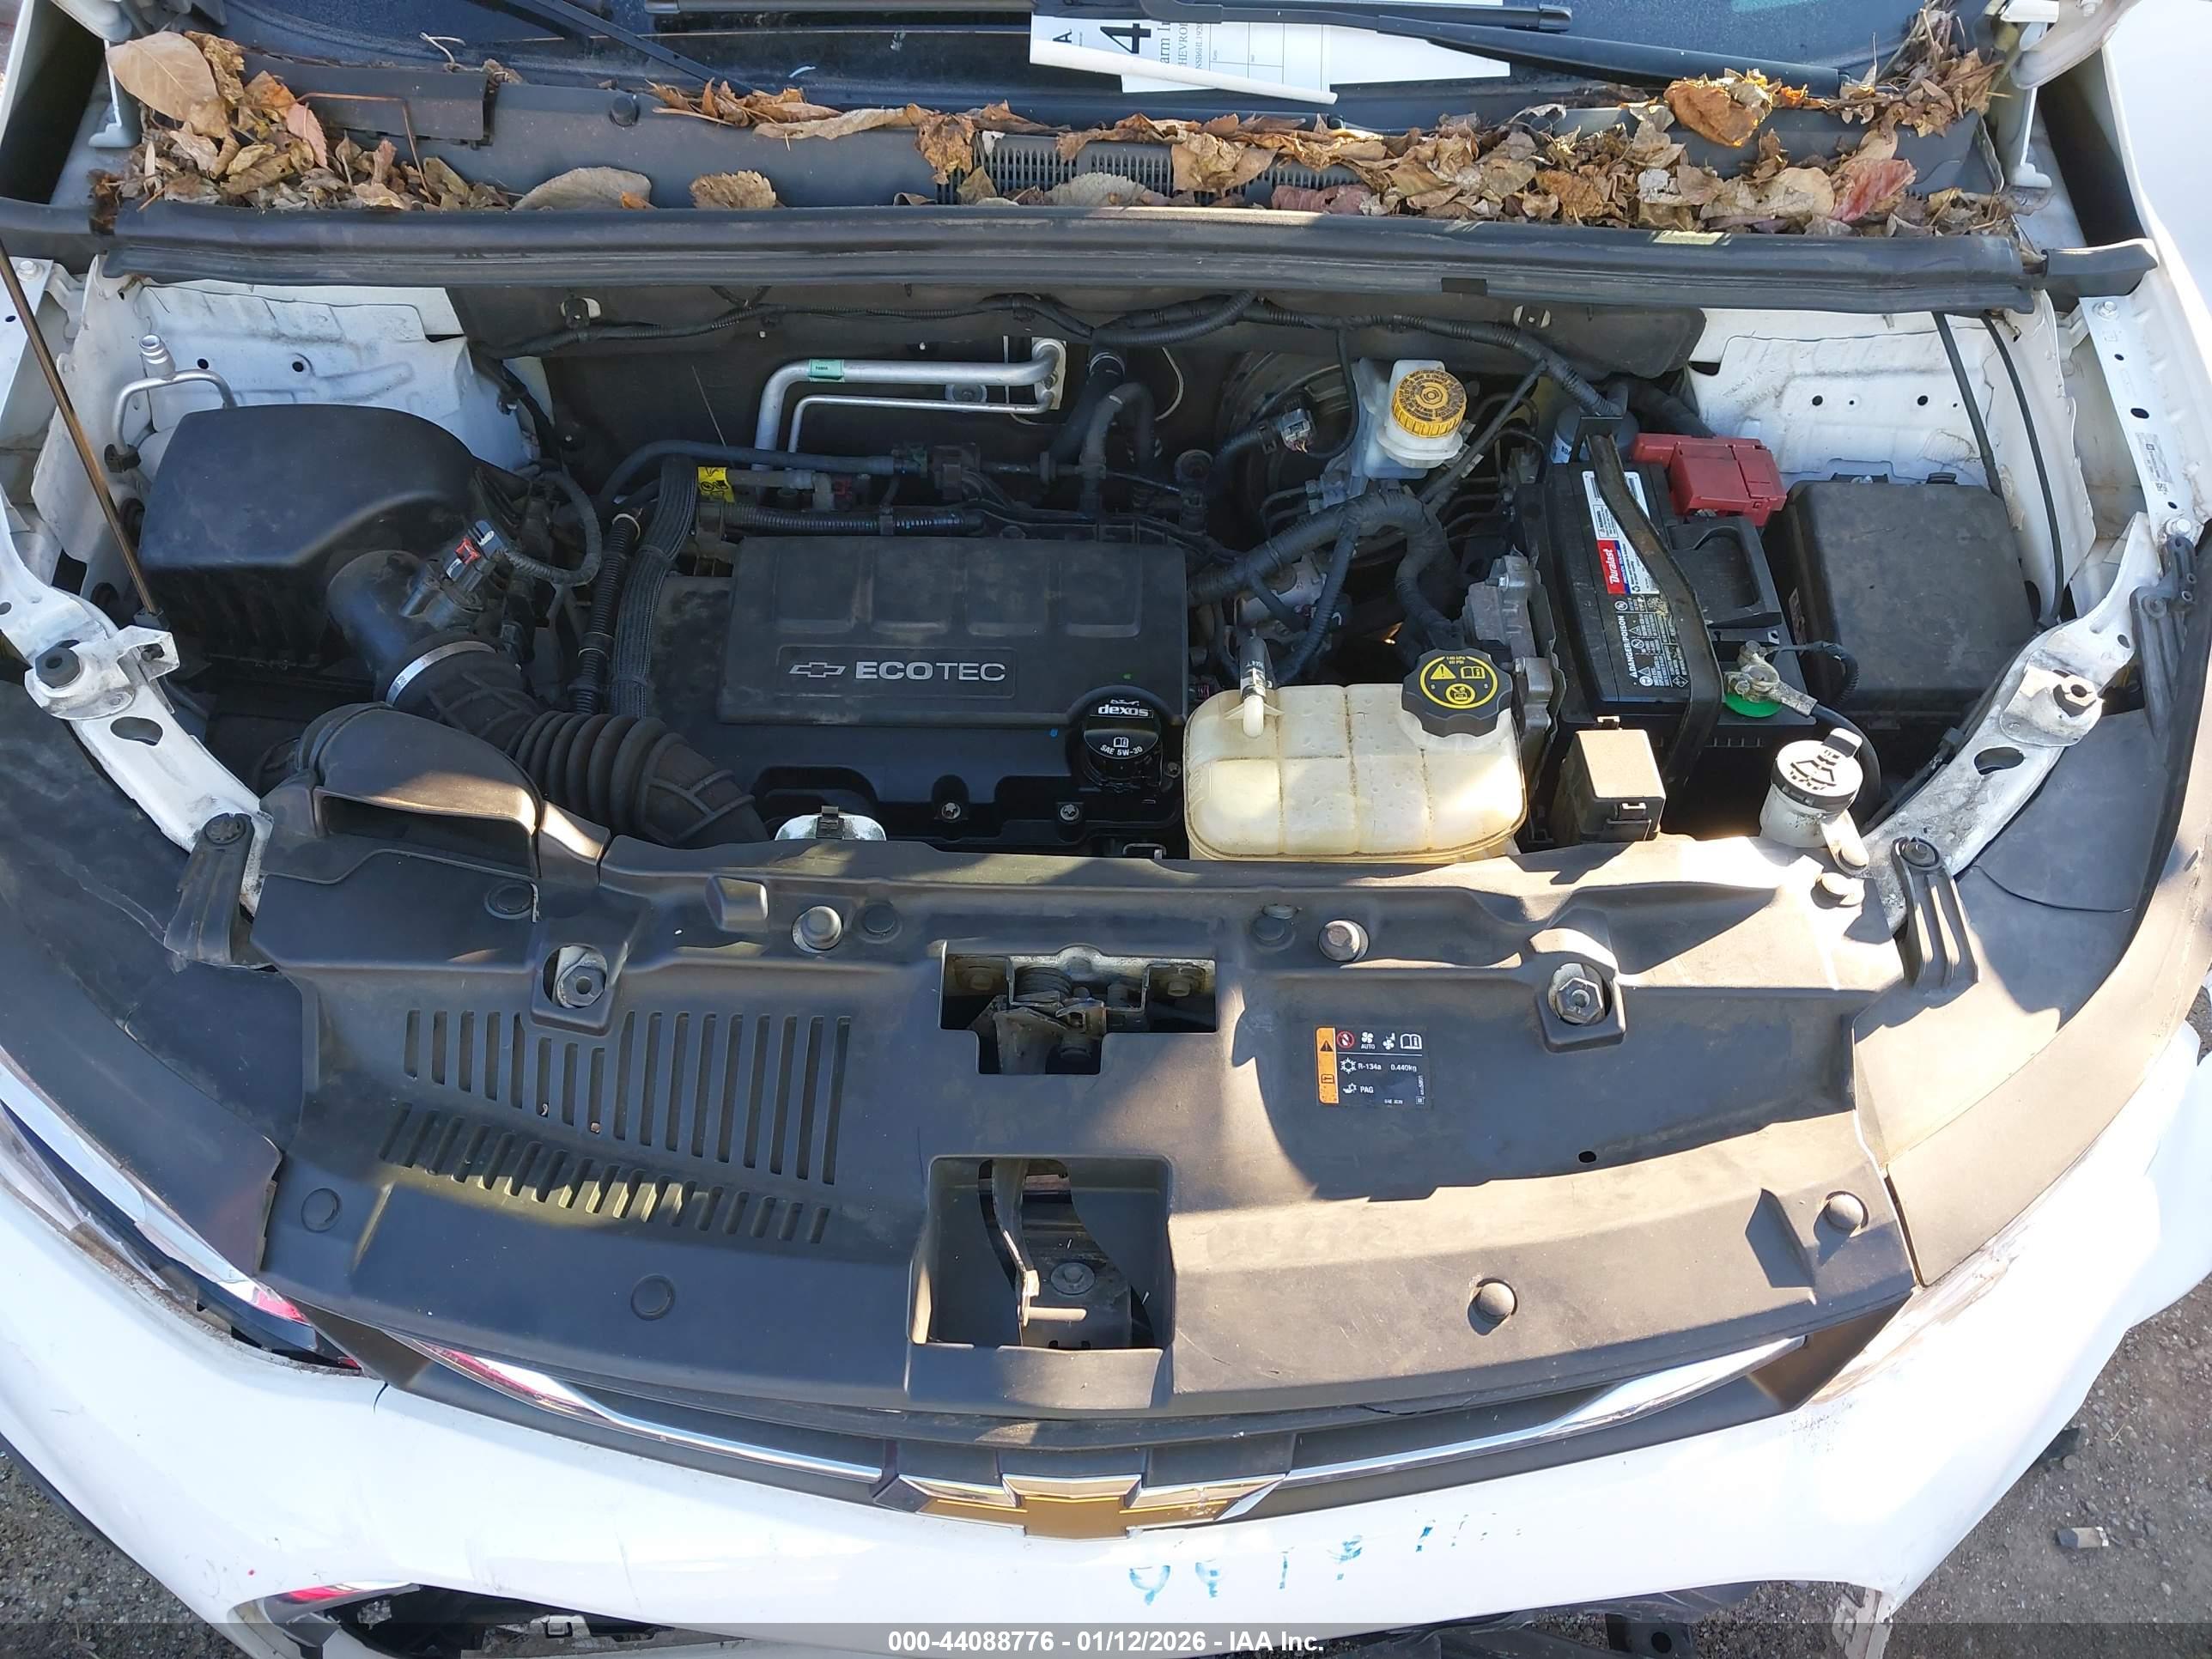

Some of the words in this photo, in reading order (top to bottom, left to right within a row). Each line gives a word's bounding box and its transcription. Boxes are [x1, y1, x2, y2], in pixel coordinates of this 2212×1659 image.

[1099, 22, 1152, 55] 4
[1602, 548, 1620, 584] Duralast
[854, 660, 1006, 682] ECOTEC
[1097, 703, 1150, 717] dexos
[1100, 744, 1115, 755] SAE
[1116, 745, 1144, 757] 5W-30
[1390, 1064, 1418, 1073] 0.440kg
[1359, 1085, 1374, 1094] PAG
